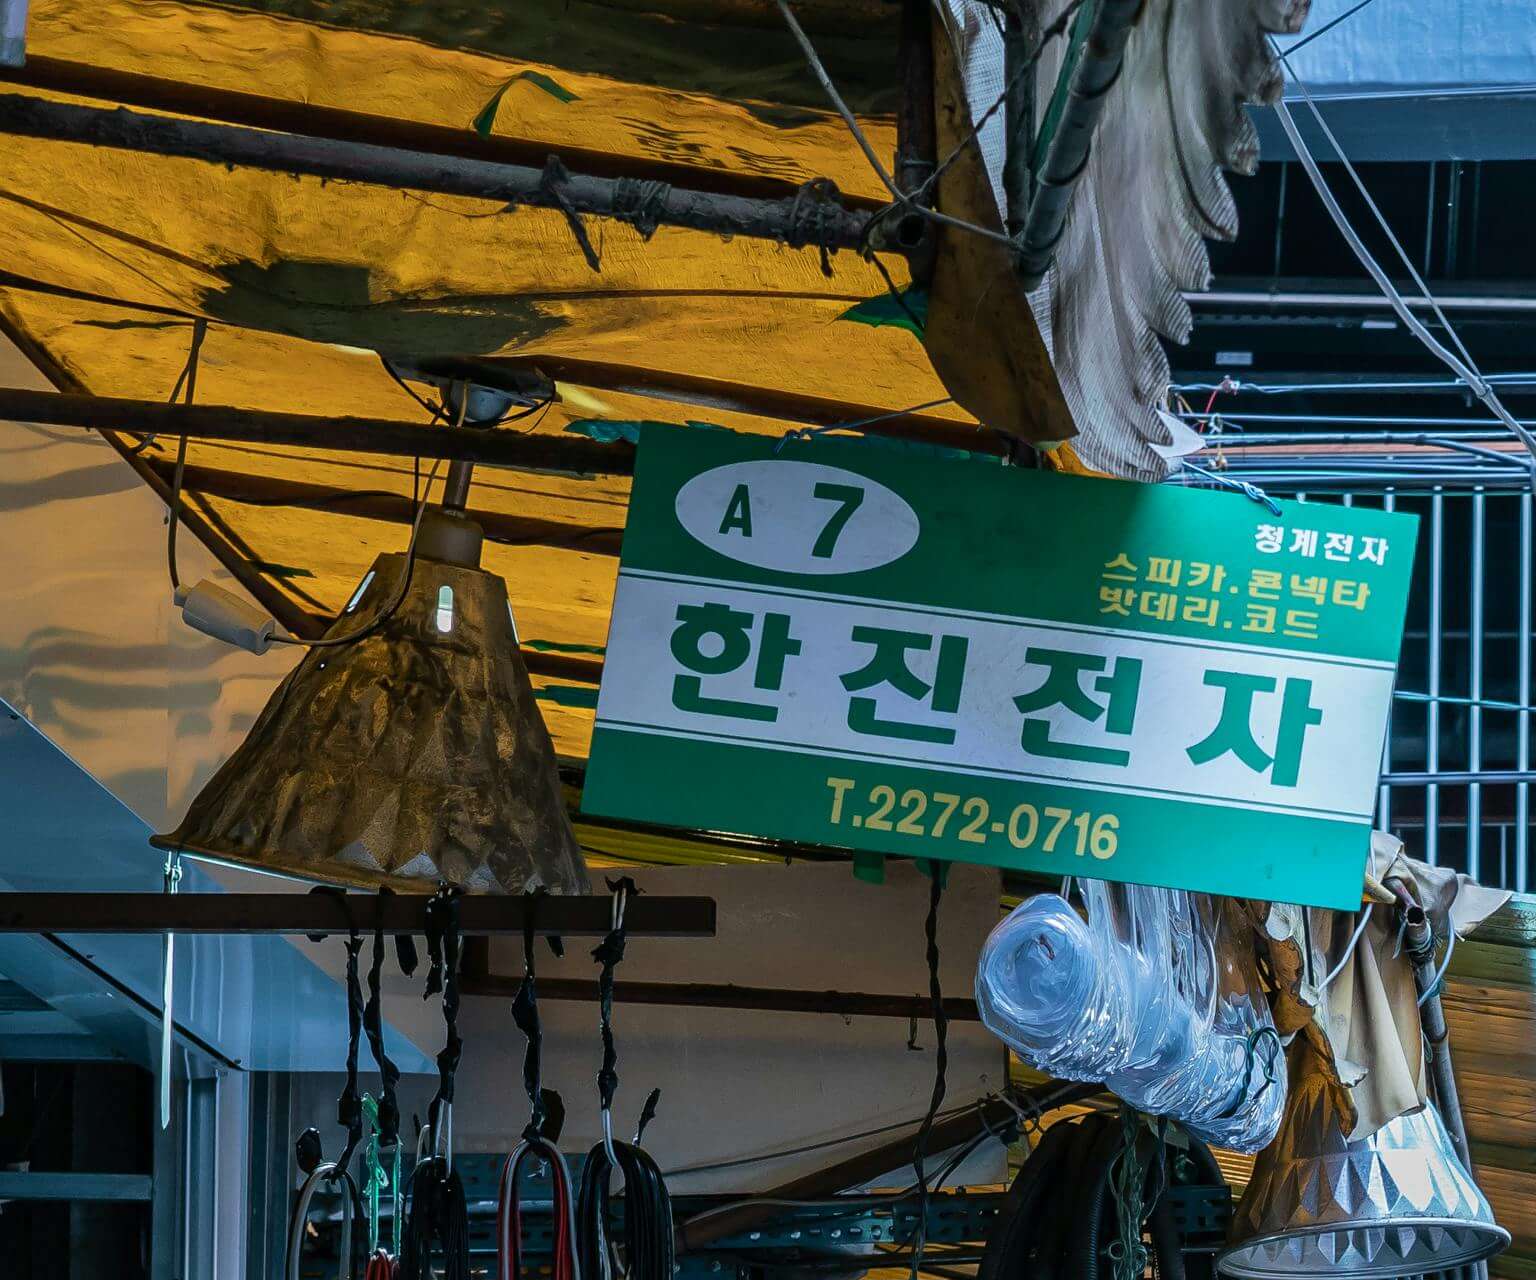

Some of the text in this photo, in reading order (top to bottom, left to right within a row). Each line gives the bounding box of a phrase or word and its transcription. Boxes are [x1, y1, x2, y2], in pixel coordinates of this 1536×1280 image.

[719, 482, 864, 558] A 7
[1254, 523, 1389, 567] 청계전자
[669, 601, 1323, 788] 한진전자
[826, 777, 1120, 861] T.2272-0716
